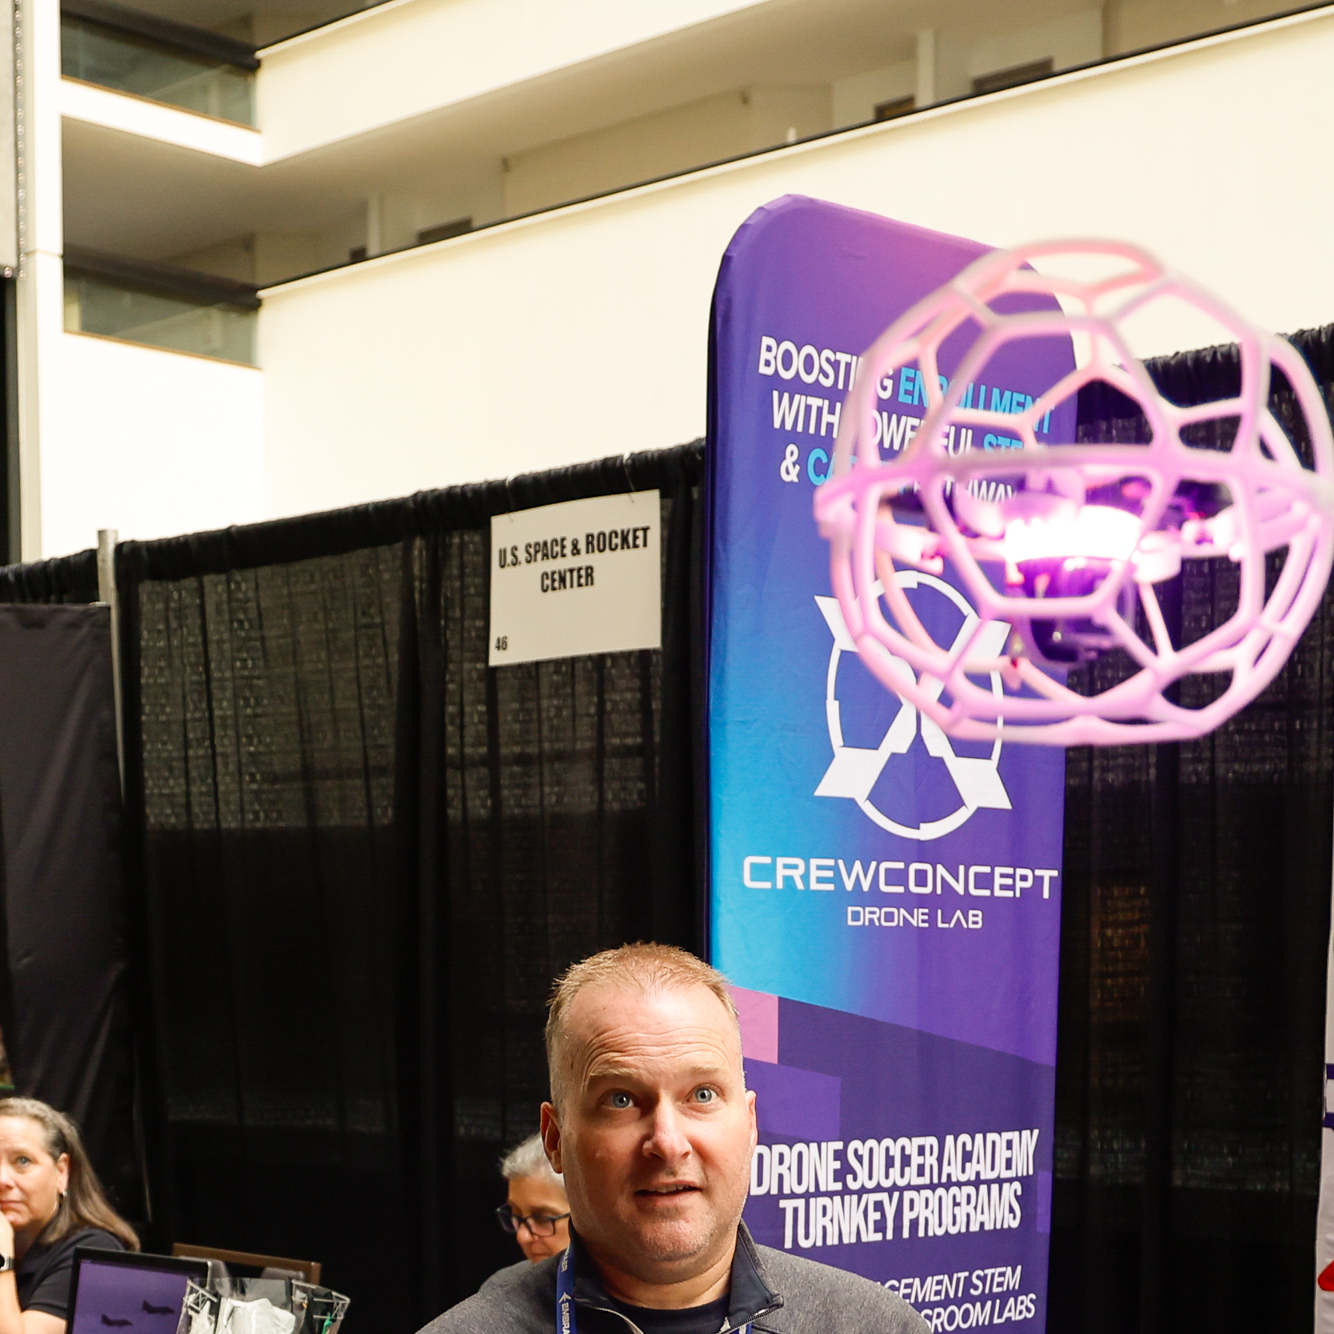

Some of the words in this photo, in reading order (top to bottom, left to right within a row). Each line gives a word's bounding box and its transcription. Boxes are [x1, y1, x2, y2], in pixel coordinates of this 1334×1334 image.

[758, 336, 893, 399] BOOSTIG
[772, 390, 841, 439] WITH
[780, 443, 801, 483] &
[499, 545, 521, 569] U.S.
[525, 536, 567, 564] SPACE
[571, 538, 581, 556] &
[586, 526, 650, 554] ROCKET
[541, 565, 594, 593] CENTER
[495, 636, 508, 651] 46
[743, 856, 1059, 898] CREWCONCEPT
[847, 906, 929, 927] DRONE
[937, 908, 983, 929] LAB
[749, 1141, 844, 1196] DRONE
[846, 1136, 939, 1189] SOCCER
[941, 1129, 1039, 1183] ACADEMY
[779, 1191, 899, 1248] TURNKEY
[903, 1181, 1022, 1238] PROGRAMS
[970, 1265, 1022, 1296] STEM
[993, 1293, 1036, 1324] LABS
